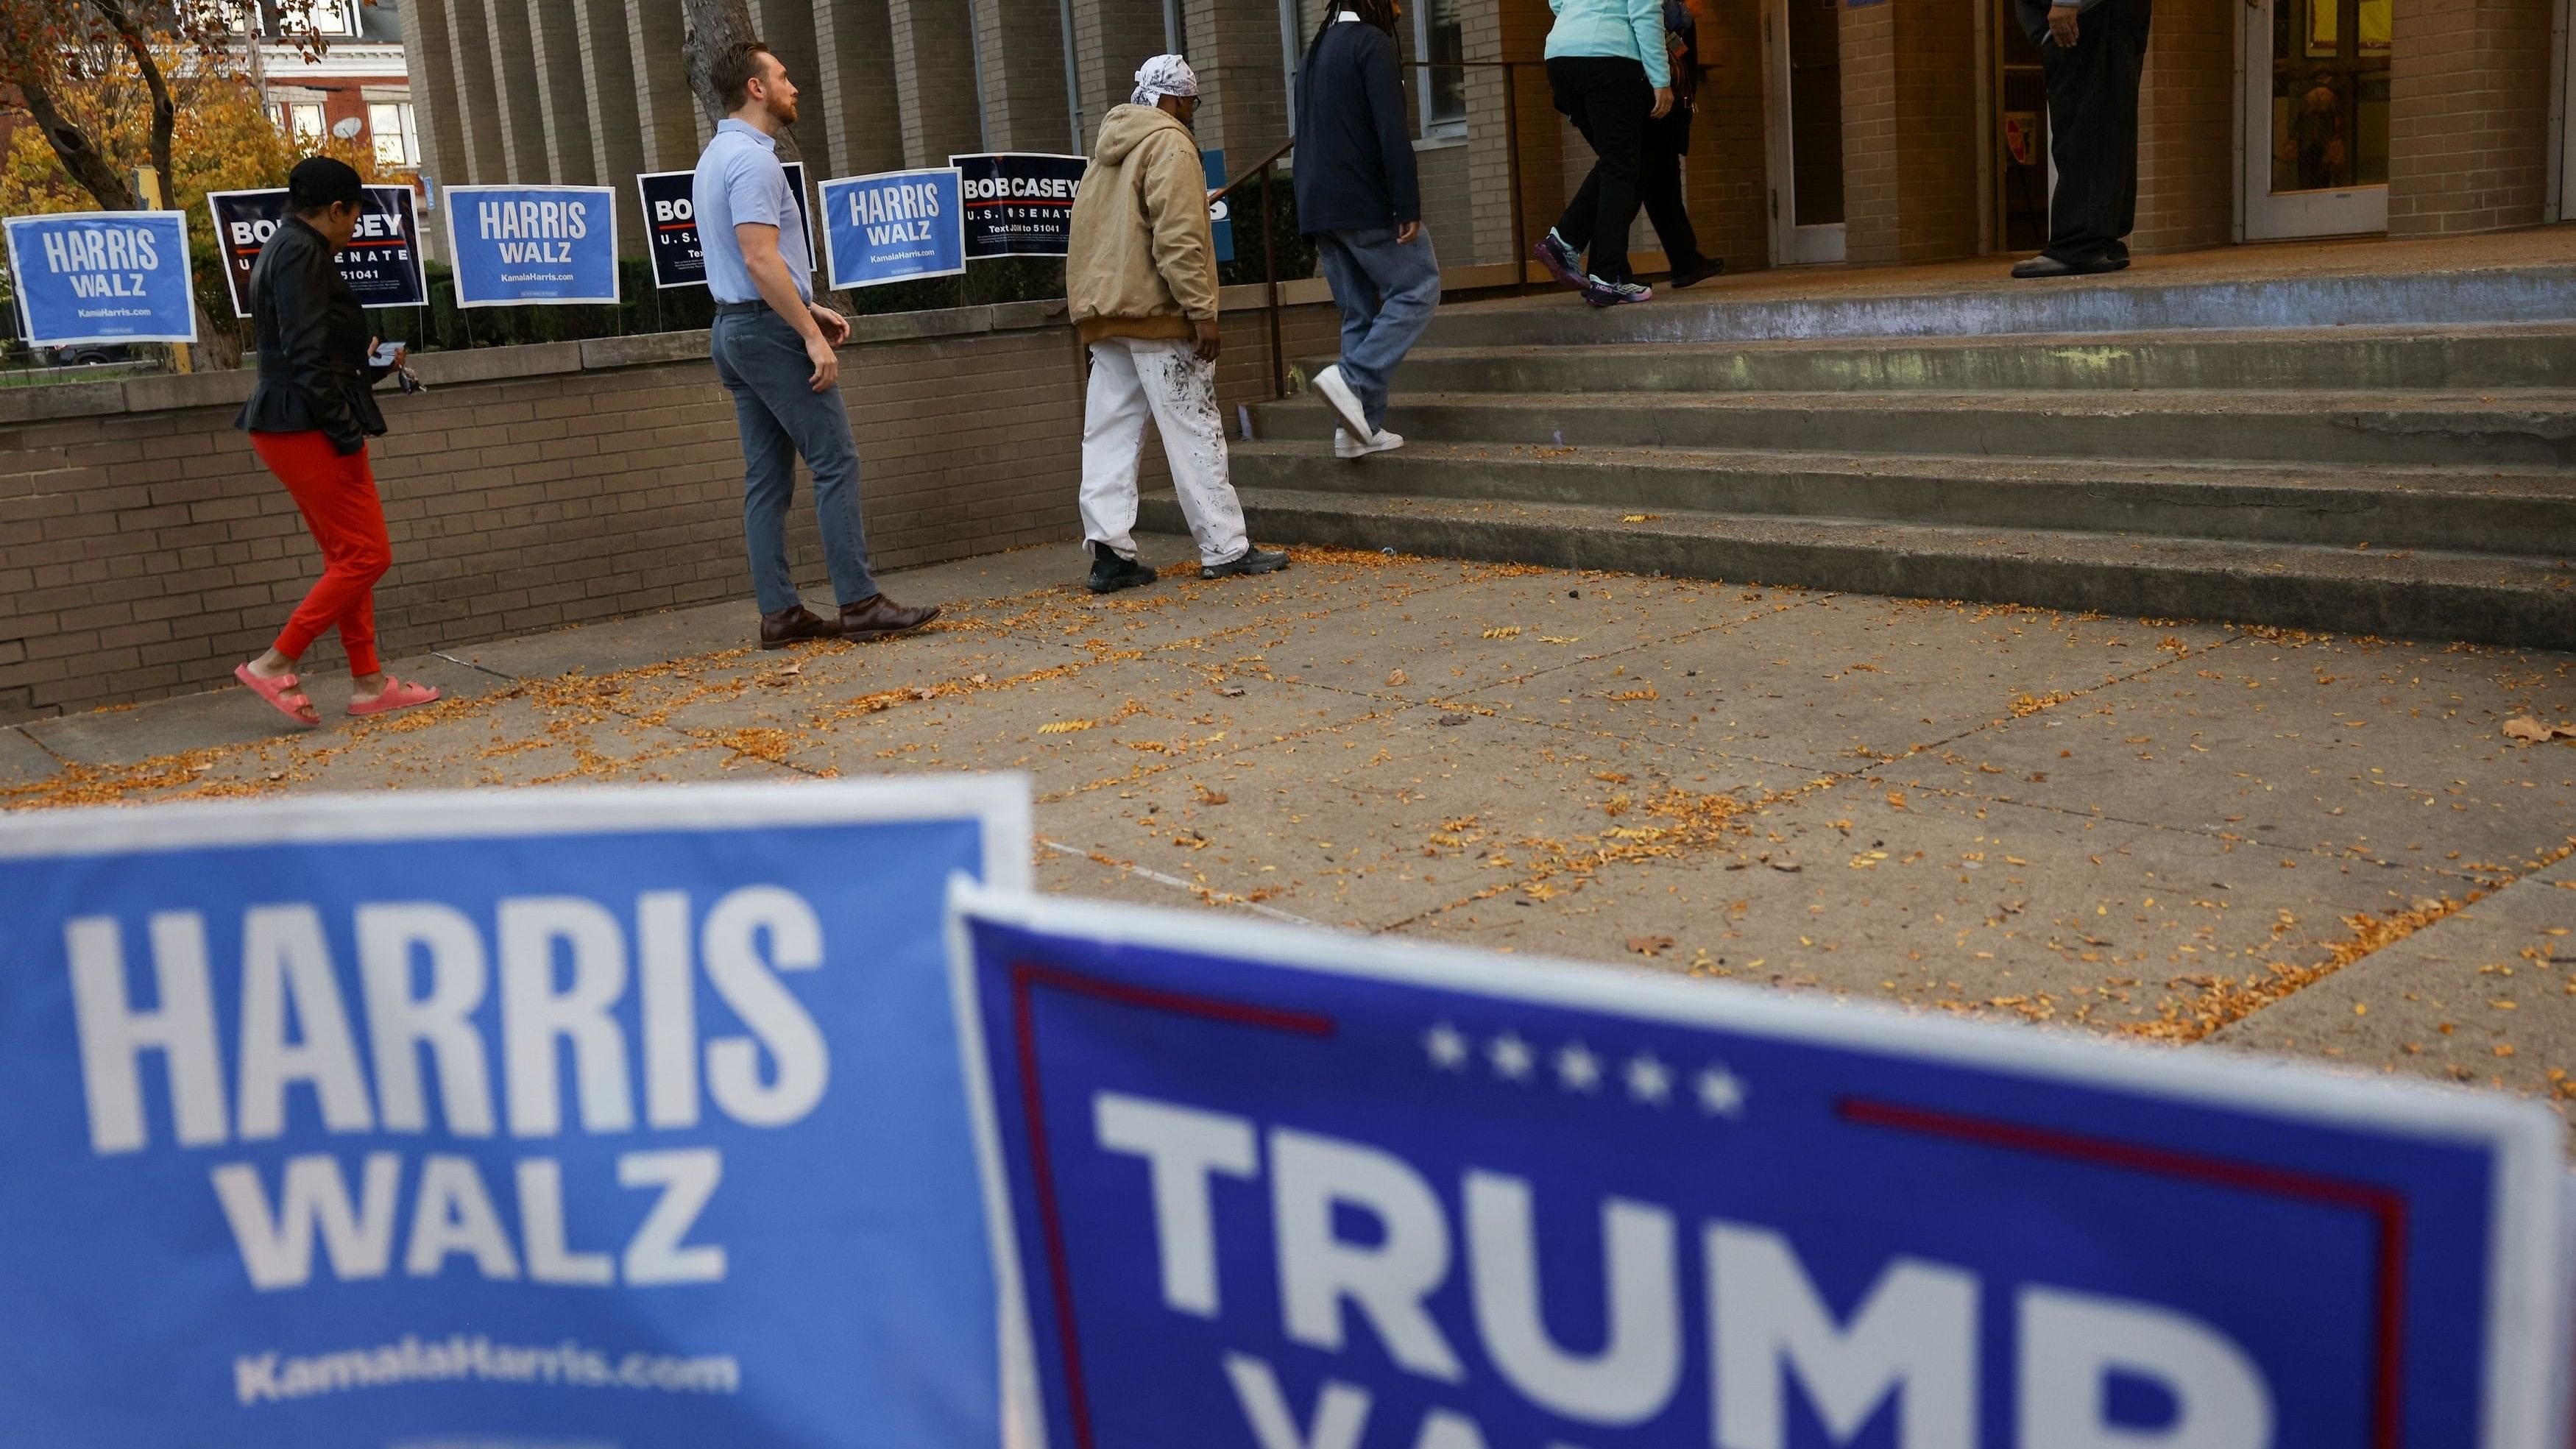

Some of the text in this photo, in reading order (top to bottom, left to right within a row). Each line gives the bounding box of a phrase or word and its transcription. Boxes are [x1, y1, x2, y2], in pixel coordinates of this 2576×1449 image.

[655, 198, 693, 222] BO
[849, 183, 939, 226] HARRIS
[968, 208, 1072, 221] U.S. SENAT
[230, 213, 402, 244] BO SEY
[478, 201, 587, 239] HARRIS
[988, 225, 1010, 233] Text
[1022, 224, 1031, 233] to
[1033, 224, 1060, 233] 51041
[660, 232, 698, 245] U.S.
[866, 220, 932, 247] WALZ
[42, 228, 159, 273] HARRIS
[334, 249, 408, 263] ENATE
[498, 241, 572, 264] WALZ
[870, 249, 935, 263] KamalaHarris.com
[69, 273, 146, 299] WALZ
[500, 272, 574, 283] KamalaHarris.com
[65, 885, 831, 1154] HARRIS
[210, 1148, 726, 1291] WALZ
[1094, 1091, 2274, 1449] TRUMP
[234, 1335, 739, 1405] KamalaHarris.com
